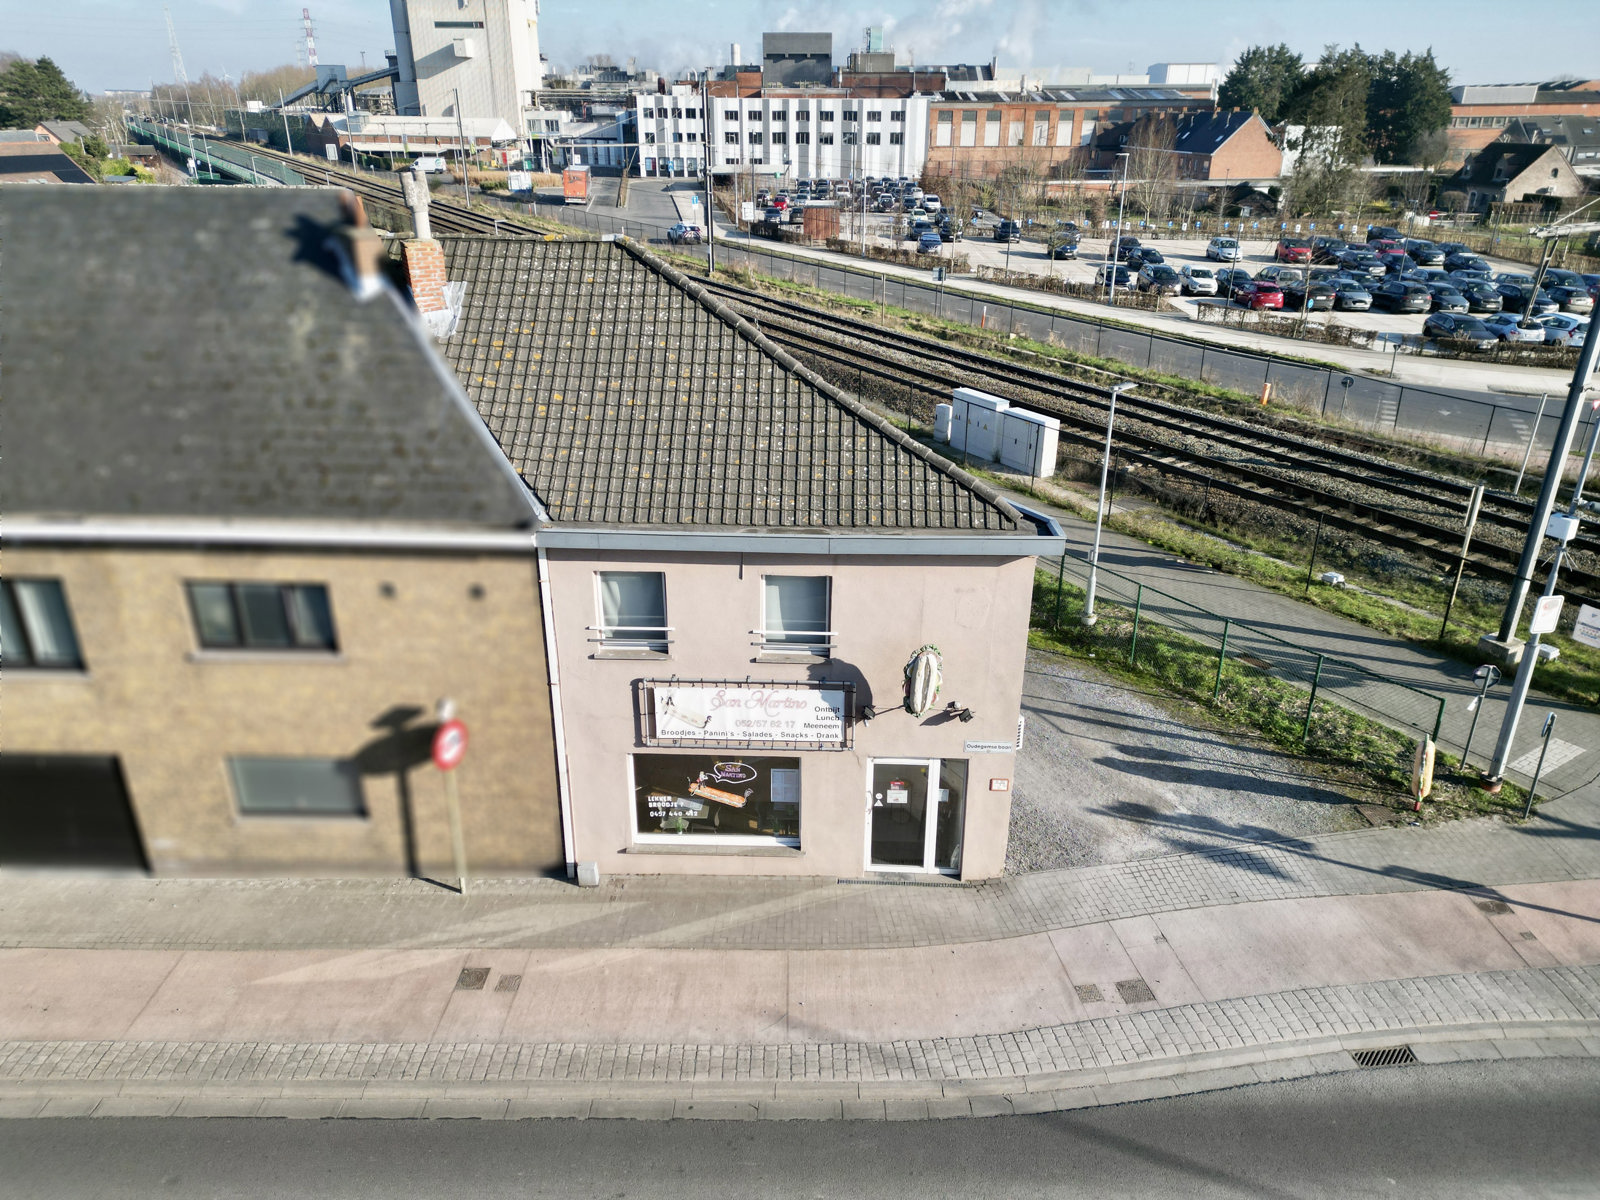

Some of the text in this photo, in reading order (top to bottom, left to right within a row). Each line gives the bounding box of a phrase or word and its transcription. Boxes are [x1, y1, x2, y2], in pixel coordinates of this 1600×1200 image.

[712, 689, 808, 717] San Martino
[814, 706, 840, 714] Ontbijt
[785, 720, 796, 728] 17
[661, 729, 696, 737] Broodjes
